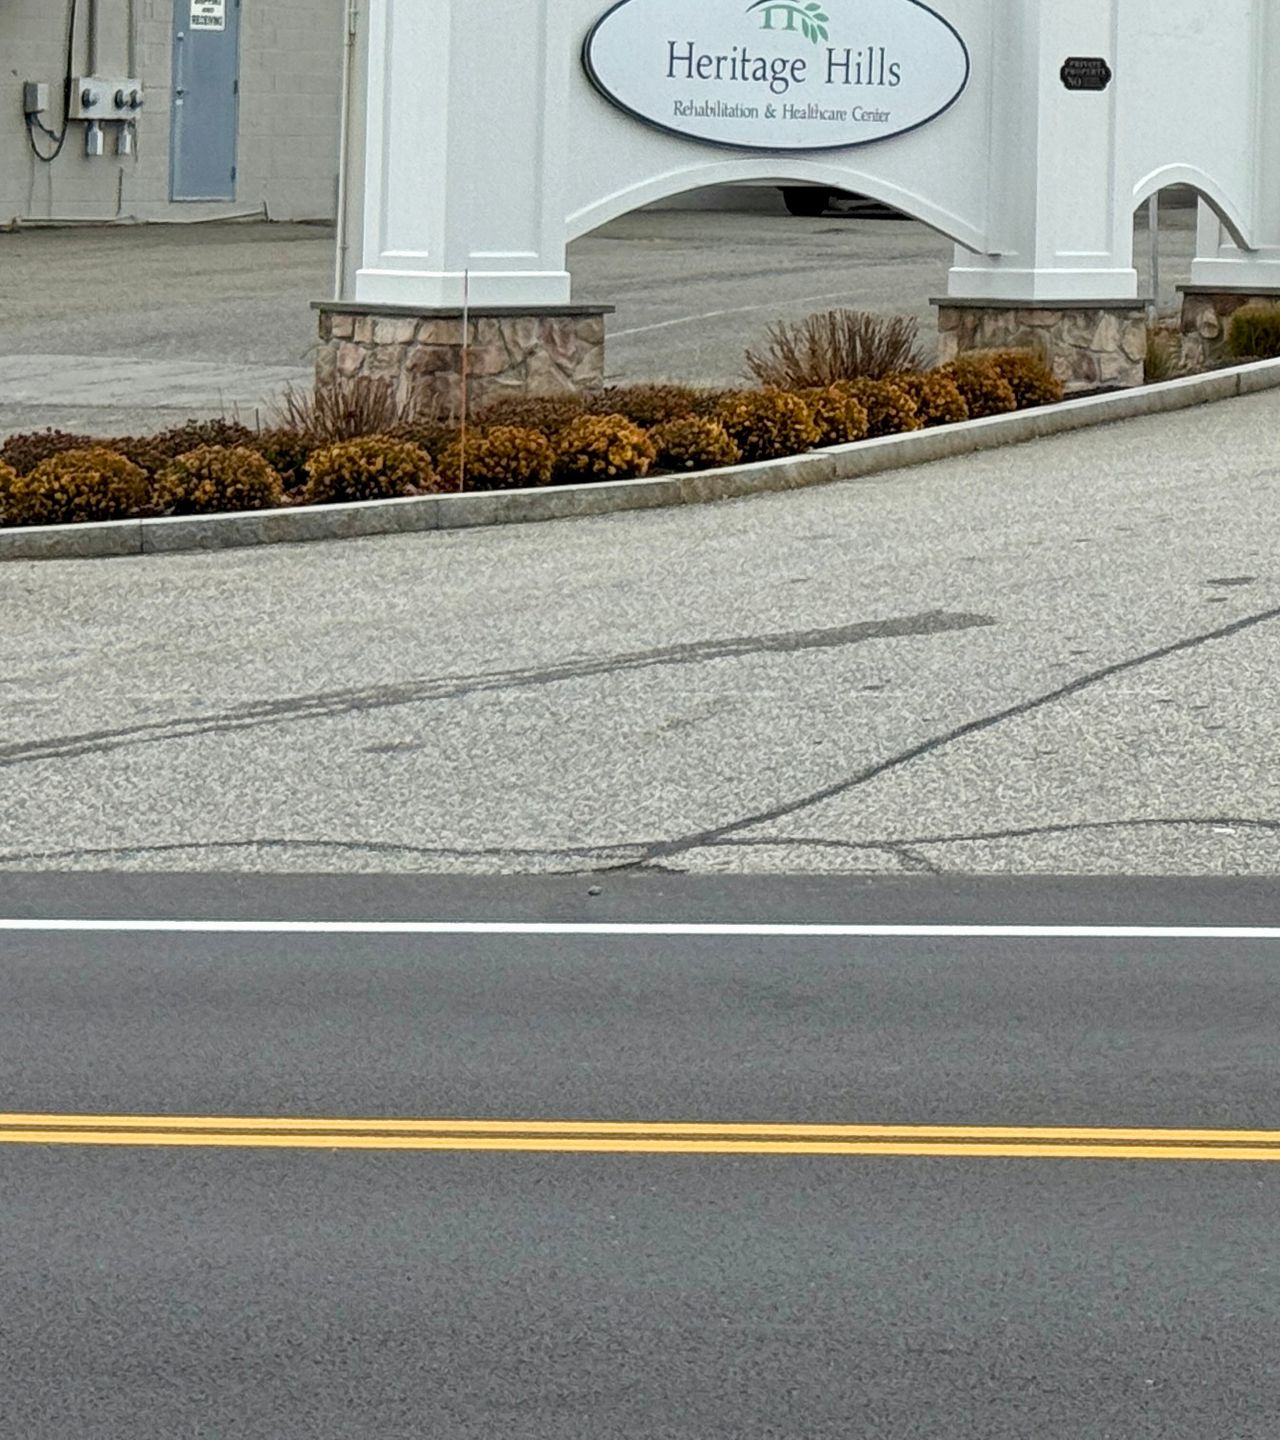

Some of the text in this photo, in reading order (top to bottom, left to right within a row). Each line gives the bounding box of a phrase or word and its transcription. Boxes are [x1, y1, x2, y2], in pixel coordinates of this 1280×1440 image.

[666, 40, 902, 95] Heritage Hills
[673, 100, 891, 124] Rehabilitation & Healthcare Center
